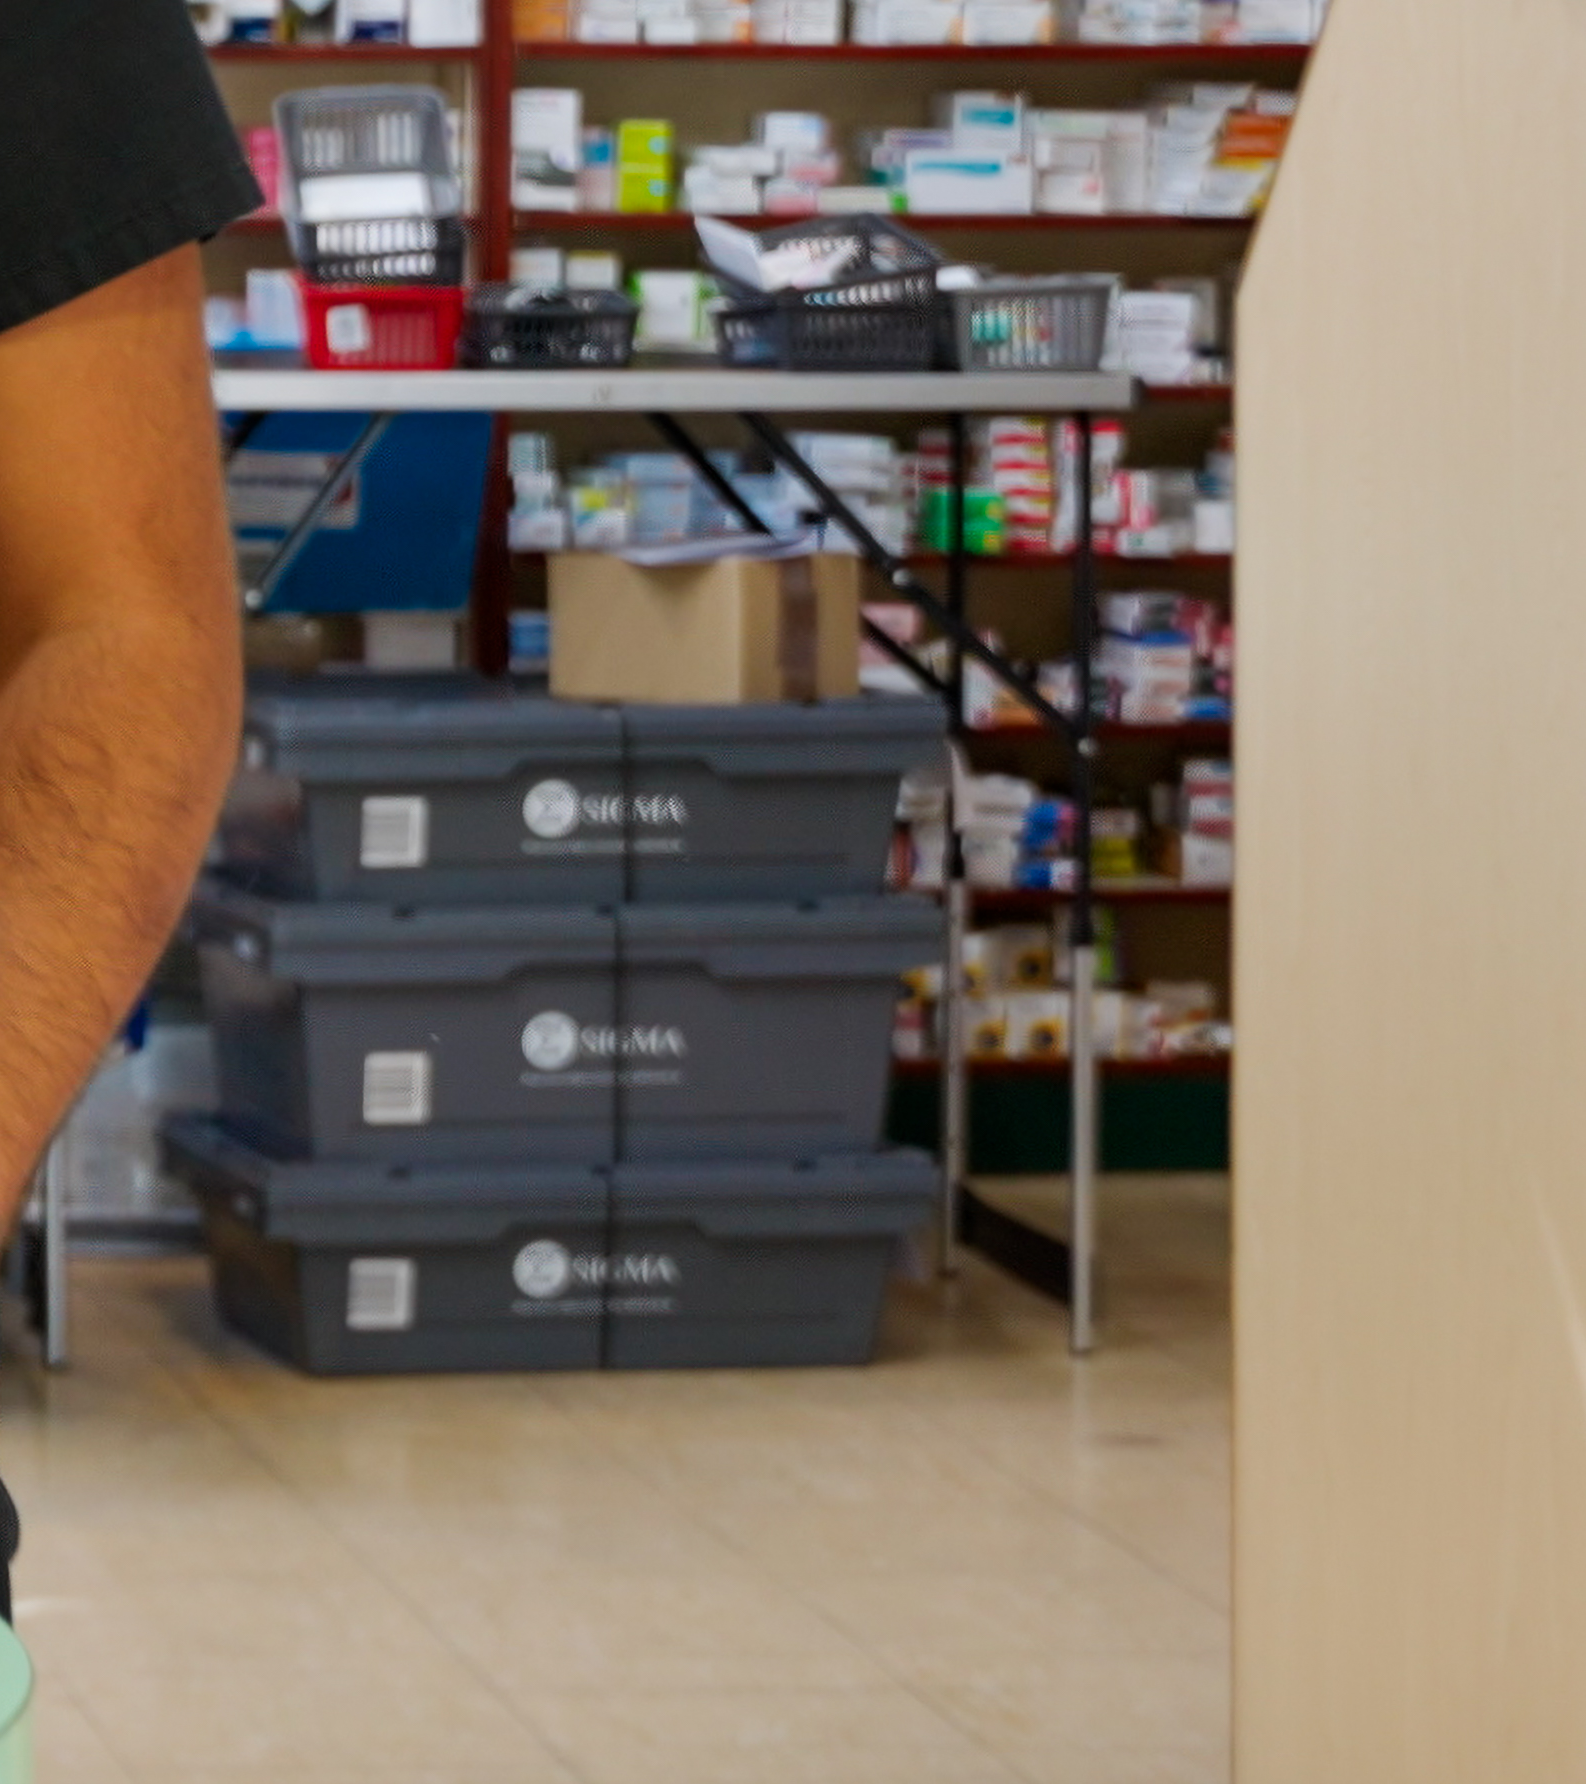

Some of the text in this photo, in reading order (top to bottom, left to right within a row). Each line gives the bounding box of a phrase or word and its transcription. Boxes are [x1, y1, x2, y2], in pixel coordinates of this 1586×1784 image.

[580, 793, 686, 827] SIGMA
[579, 1024, 686, 1058] SIGMA
[570, 1253, 680, 1286] SIGMA
